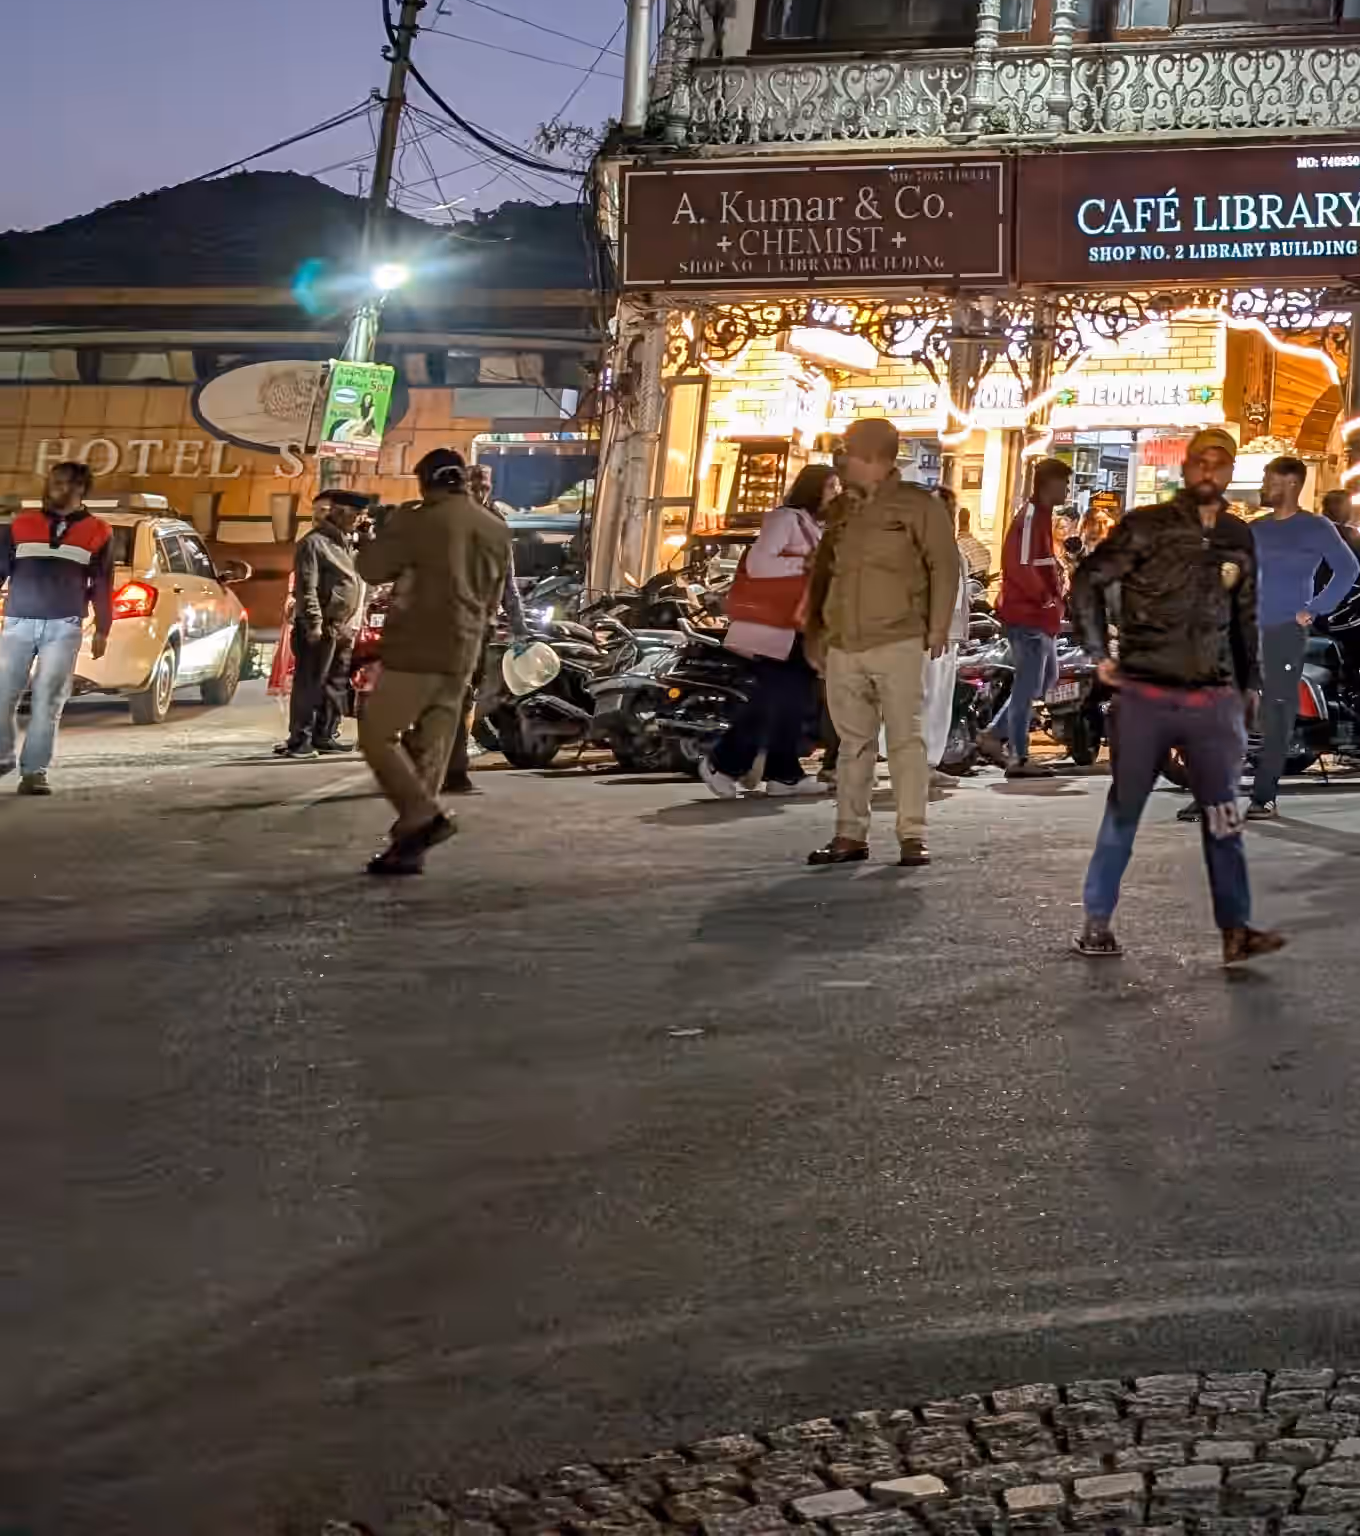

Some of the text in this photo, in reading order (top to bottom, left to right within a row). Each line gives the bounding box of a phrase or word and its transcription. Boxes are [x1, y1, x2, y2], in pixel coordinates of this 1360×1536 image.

[671, 184, 955, 225] A. Kumar & Co.
[1076, 186, 1182, 235] CAFÉ
[738, 226, 884, 256] CHEMIST
[1088, 239, 1359, 263] SHOP NO. 2 LIBRARY BUILDING
[779, 258, 855, 273] LIBRARY
[33, 437, 242, 479] HOTEL
